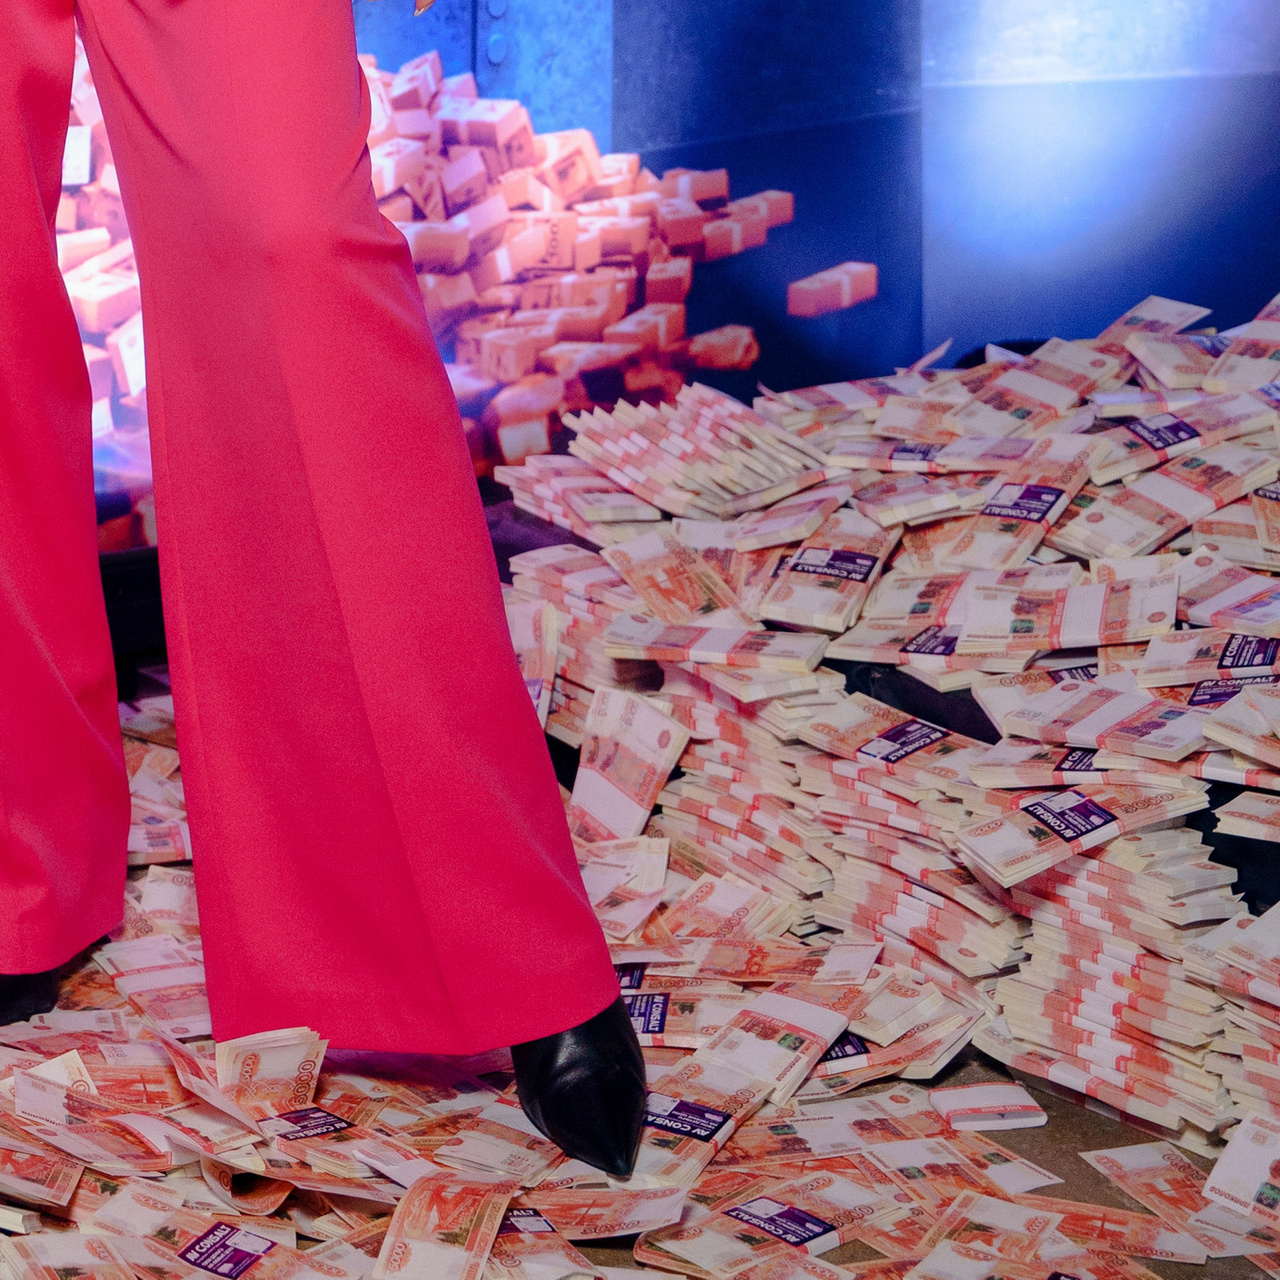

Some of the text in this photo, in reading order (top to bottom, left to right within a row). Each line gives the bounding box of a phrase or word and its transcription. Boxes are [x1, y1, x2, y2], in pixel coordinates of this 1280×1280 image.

[1201, 676, 1275, 688] AV CONSALT
[1028, 804, 1077, 838] AV CONSALT
[649, 1007, 663, 1032] CONSALT
[241, 1053, 258, 1083] 5000
[292, 1058, 317, 1107] 5000
[645, 1114, 711, 1137] AV CONSA
[1208, 1185, 1251, 1209] ПРИКОЛОВ
[195, 1224, 233, 1253] CONSALT
[729, 1210, 801, 1242] AV CONSALT
[387, 1242, 406, 1272] 5000
